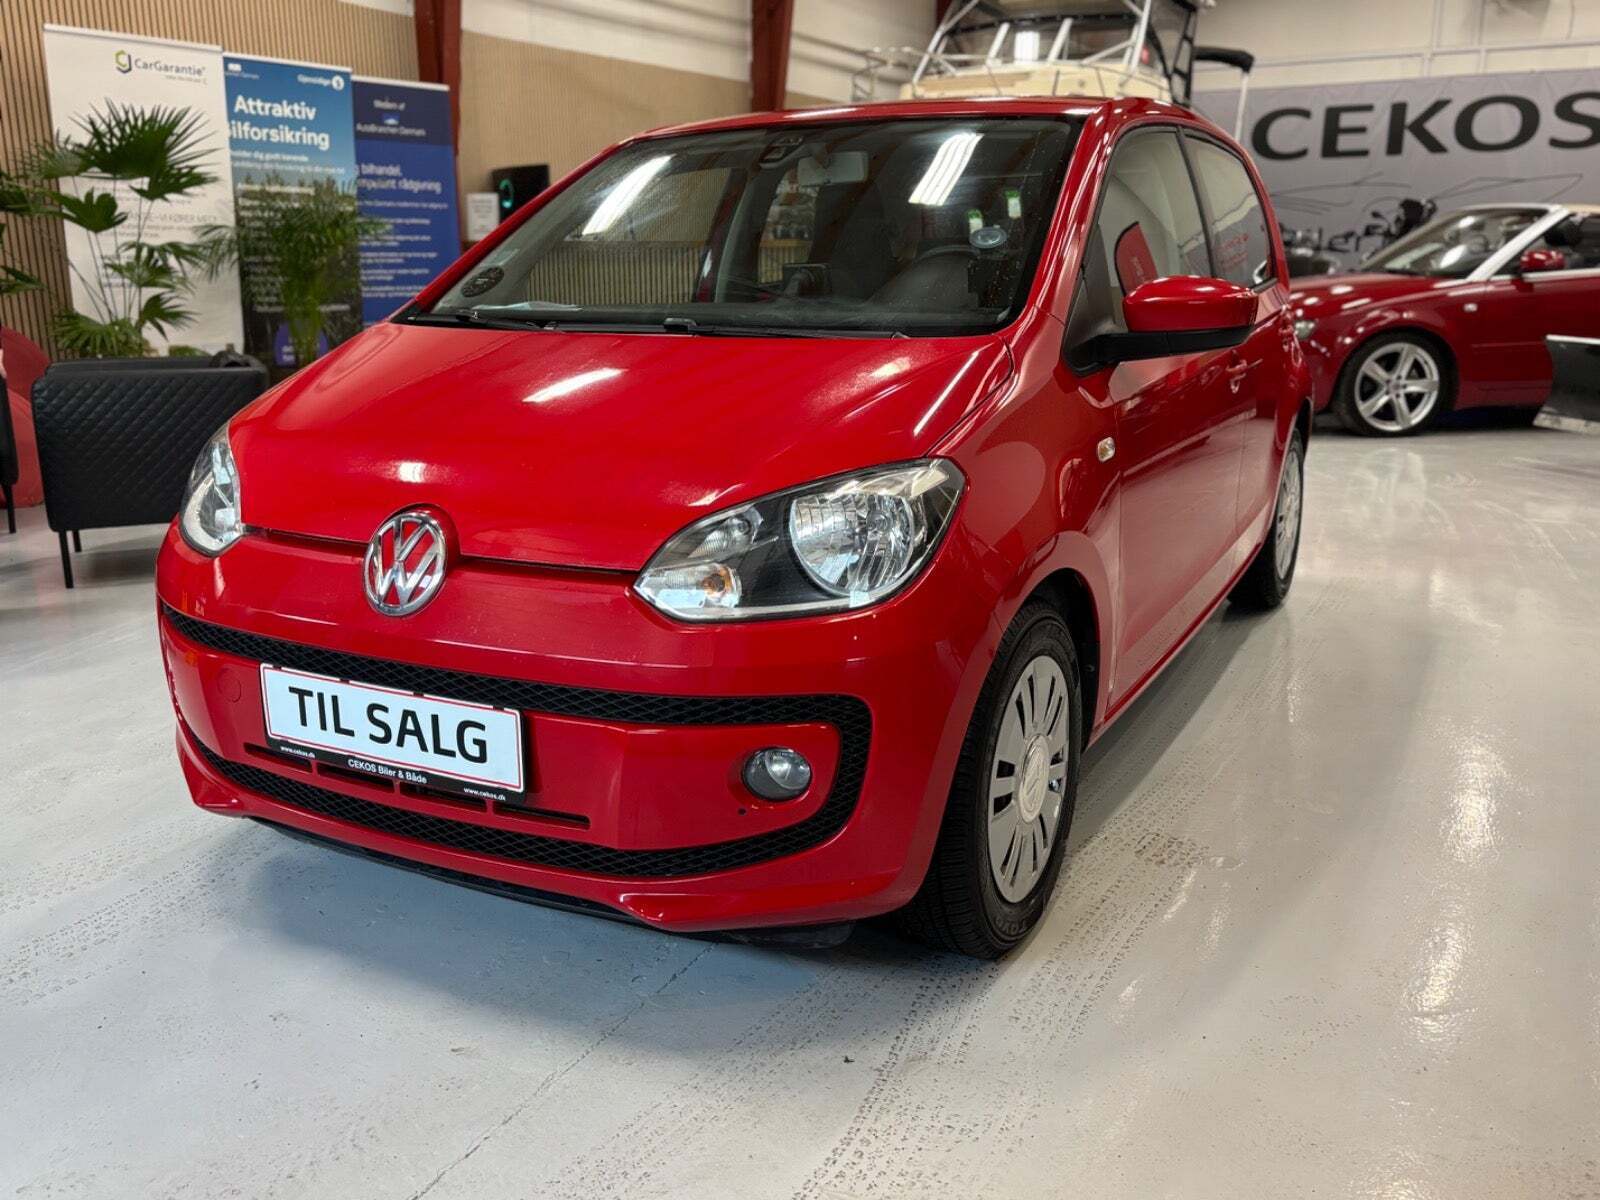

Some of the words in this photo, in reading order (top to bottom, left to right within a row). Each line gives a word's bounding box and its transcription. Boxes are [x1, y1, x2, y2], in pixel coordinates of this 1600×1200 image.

[134, 58, 202, 76] CarGarantie
[234, 94, 316, 120] Attraktiv
[1251, 91, 1600, 161] CEKOS
[288, 686, 356, 738] TIL
[366, 702, 488, 764] SALG
[347, 758, 377, 773] CEKOS
[378, 765, 396, 777] Biler
[398, 770, 405, 780] &
[405, 771, 428, 784] Både
[463, 786, 507, 802] www.cekos.dk
